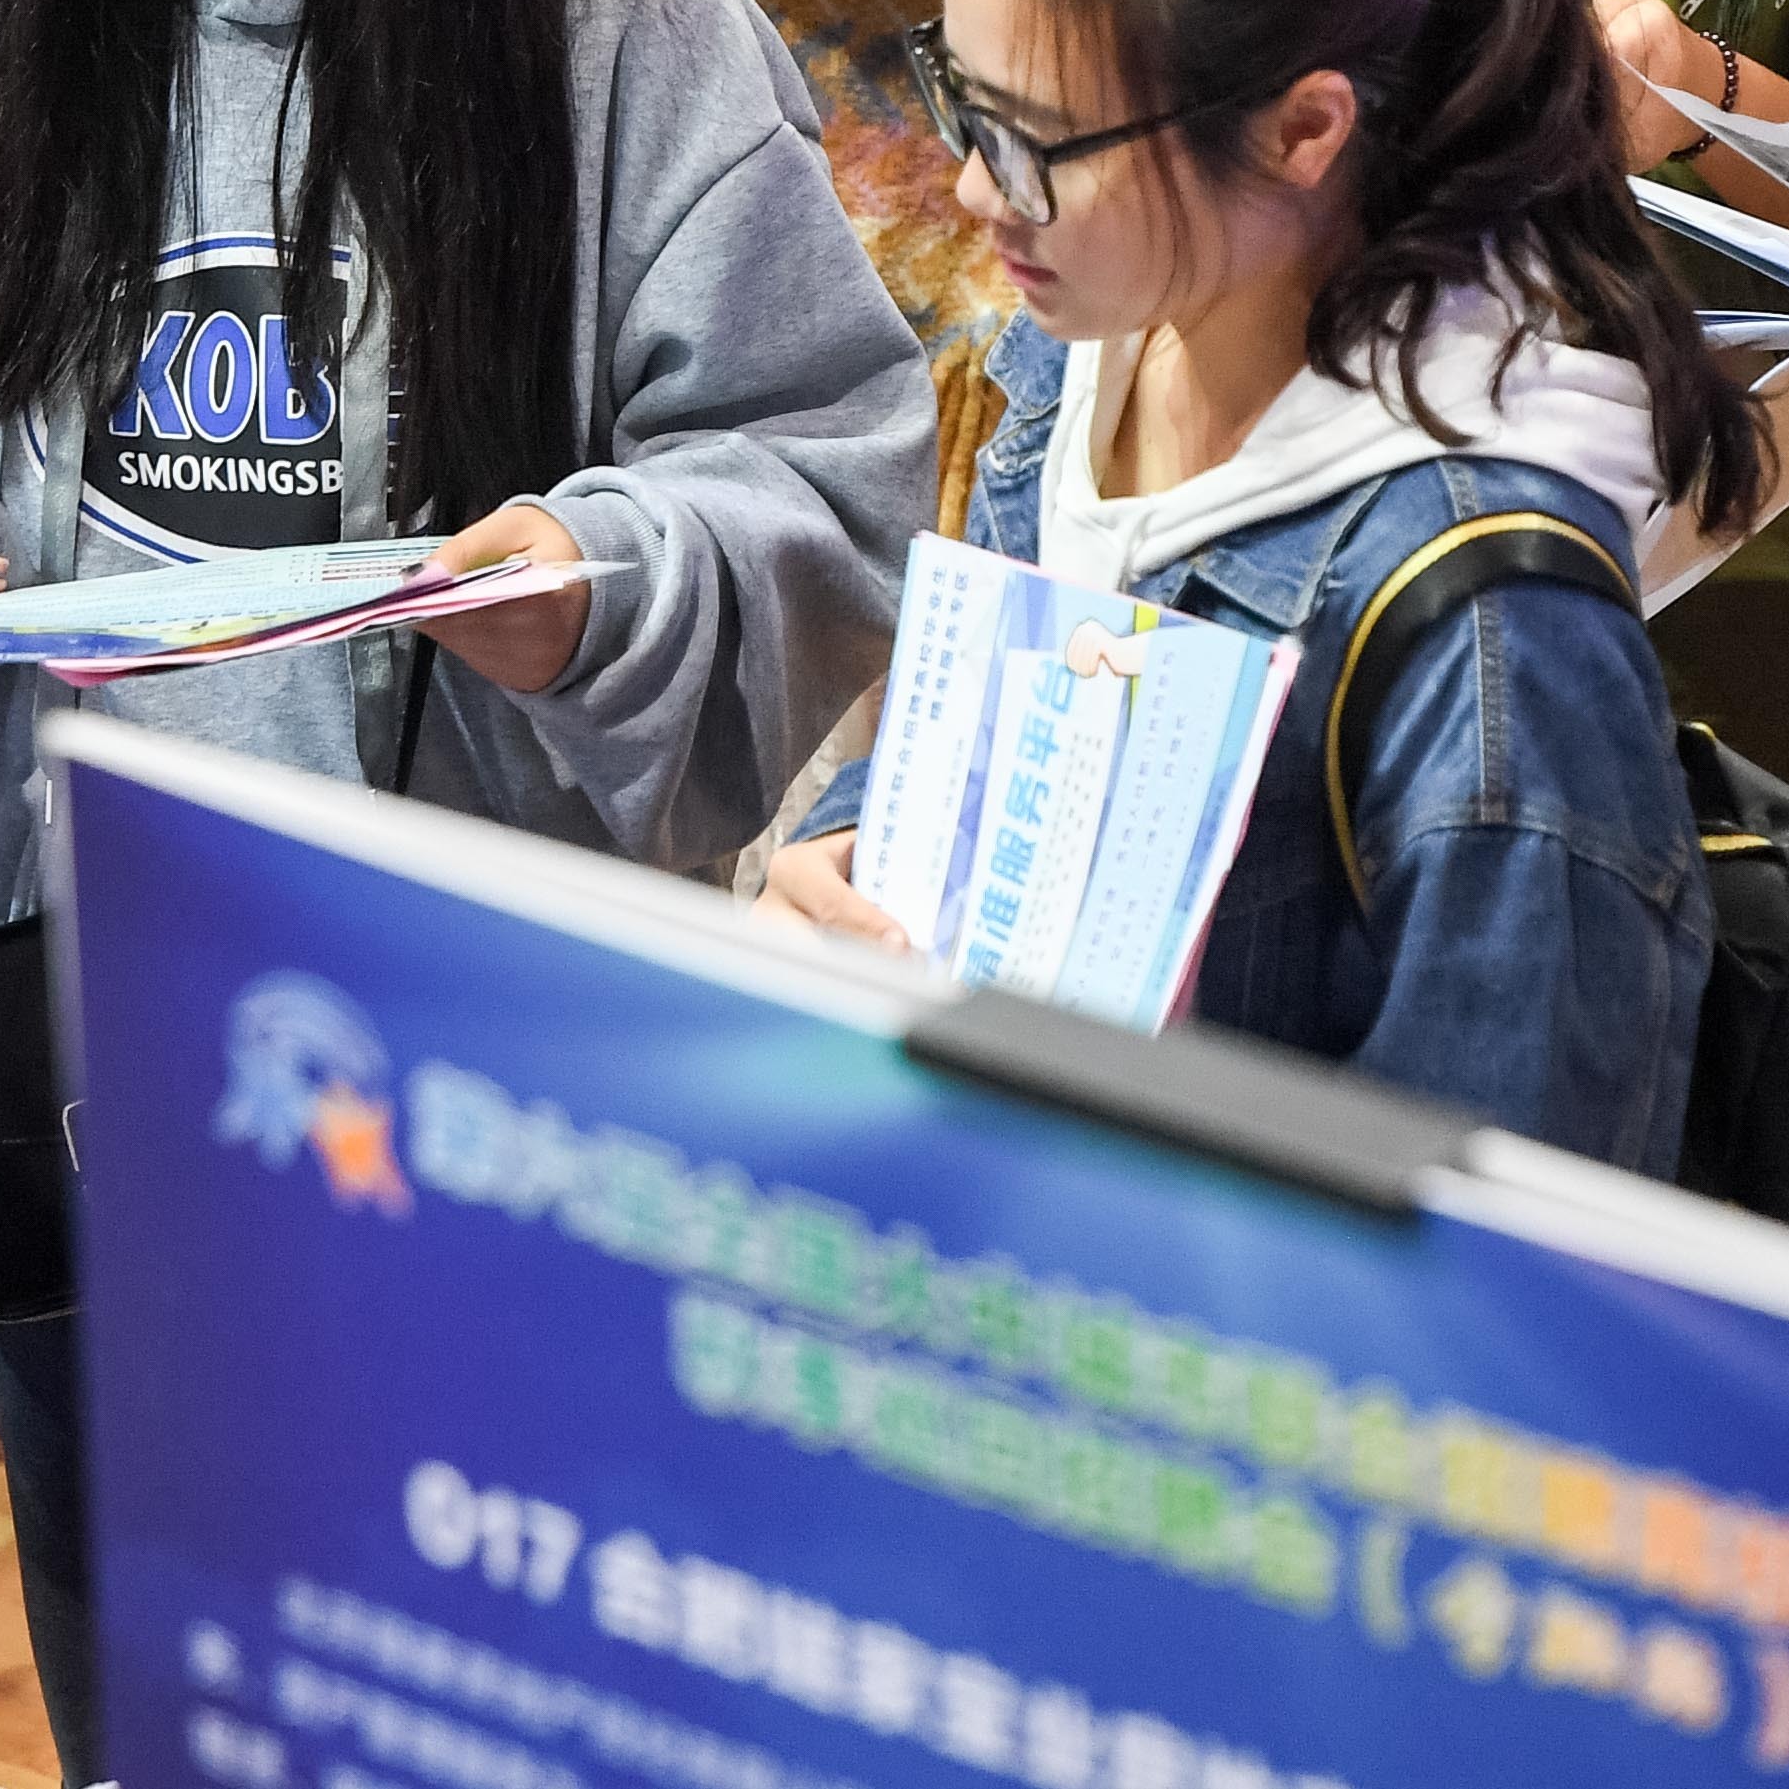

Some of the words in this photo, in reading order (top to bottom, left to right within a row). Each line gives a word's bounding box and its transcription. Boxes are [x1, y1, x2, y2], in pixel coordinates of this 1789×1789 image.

[119, 451, 344, 496] SMOKINGSB
[871, 564, 949, 902] 大中城市联合招聘高校毕业生
[404, 1459, 580, 1603] 017
